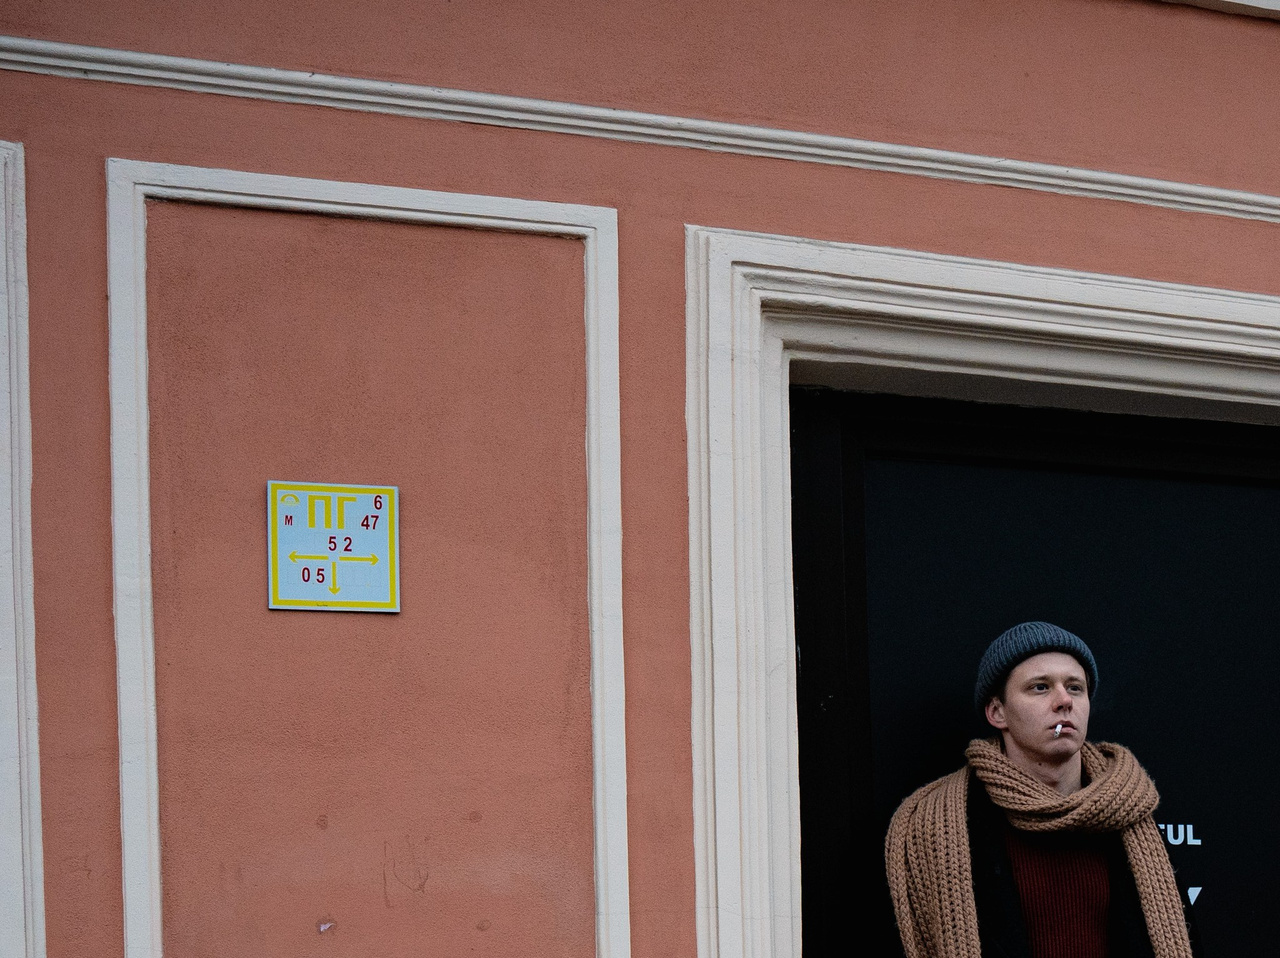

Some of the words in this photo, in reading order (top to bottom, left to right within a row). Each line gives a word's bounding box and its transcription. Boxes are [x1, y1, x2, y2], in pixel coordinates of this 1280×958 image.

[373, 495, 383, 510] 6
[308, 494, 357, 529] ПГ
[360, 515, 380, 530] 47
